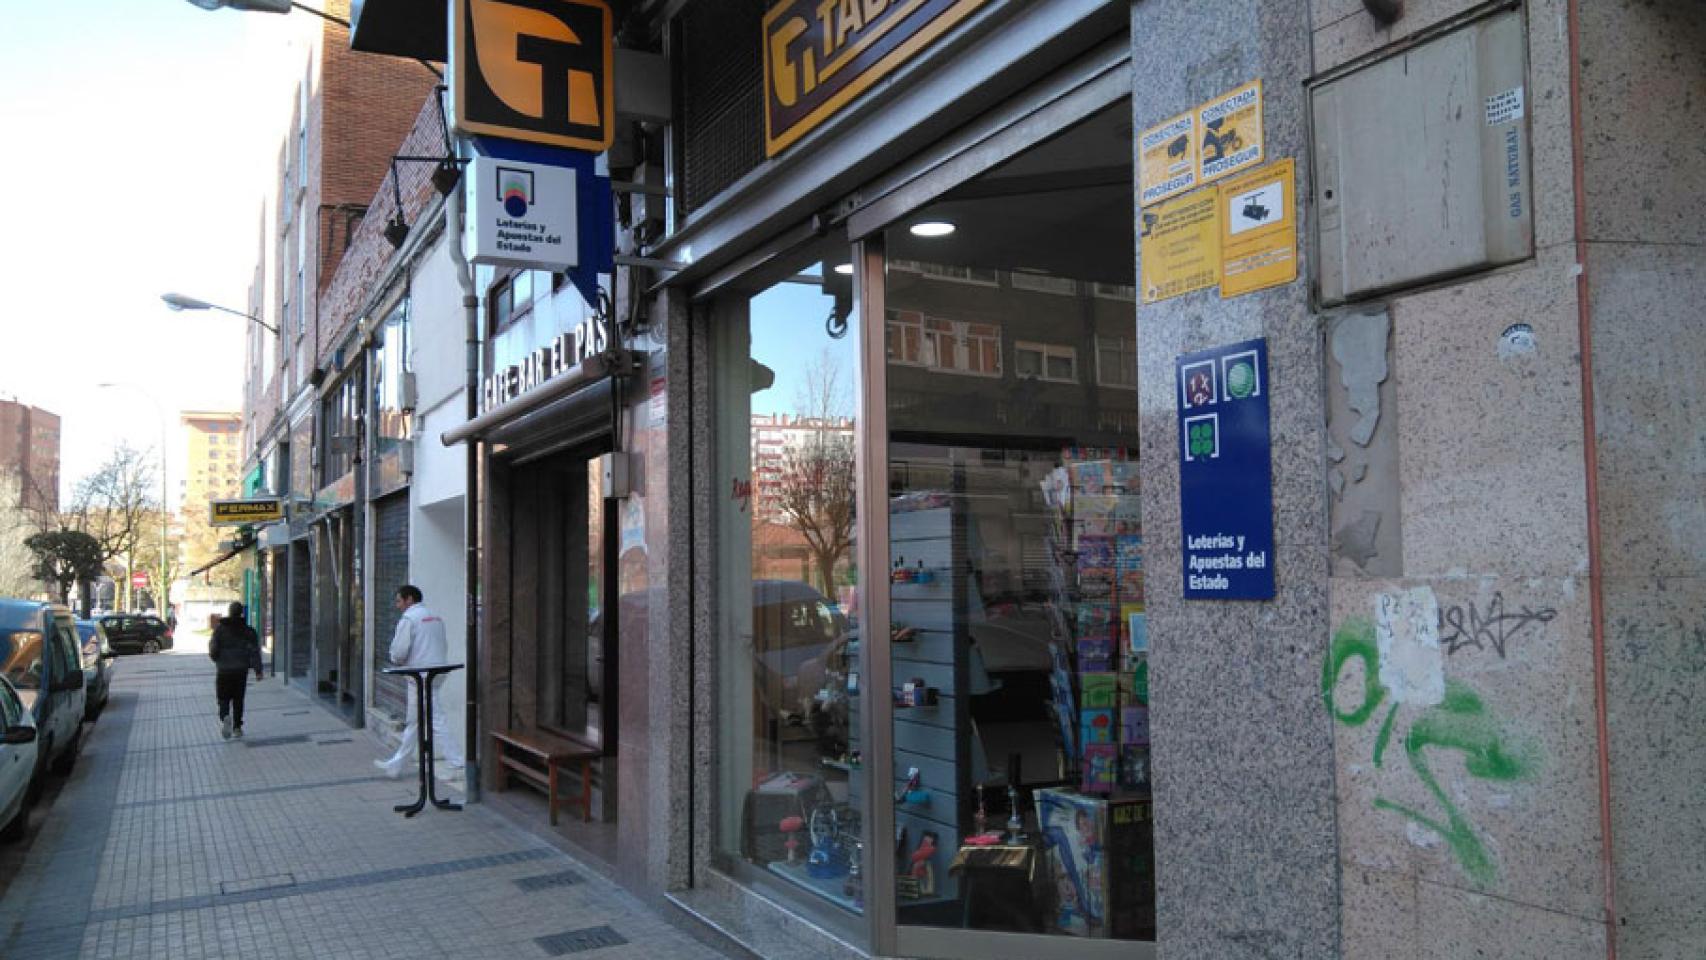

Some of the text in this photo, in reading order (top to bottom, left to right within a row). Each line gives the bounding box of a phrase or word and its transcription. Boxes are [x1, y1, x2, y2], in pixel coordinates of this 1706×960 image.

[815, 0, 894, 57] TAB
[1203, 146, 1259, 176] PROSEGUR
[1506, 127, 1521, 187] NATURAL
[1143, 172, 1193, 199] PROSEGUR
[497, 229, 543, 242] Apuestas
[496, 240, 531, 252] Estado
[218, 503, 276, 513] FERMAX
[1237, 535, 1246, 552] y
[1189, 551, 1266, 573] Apuestas del
[1189, 573, 1229, 590] Estado
